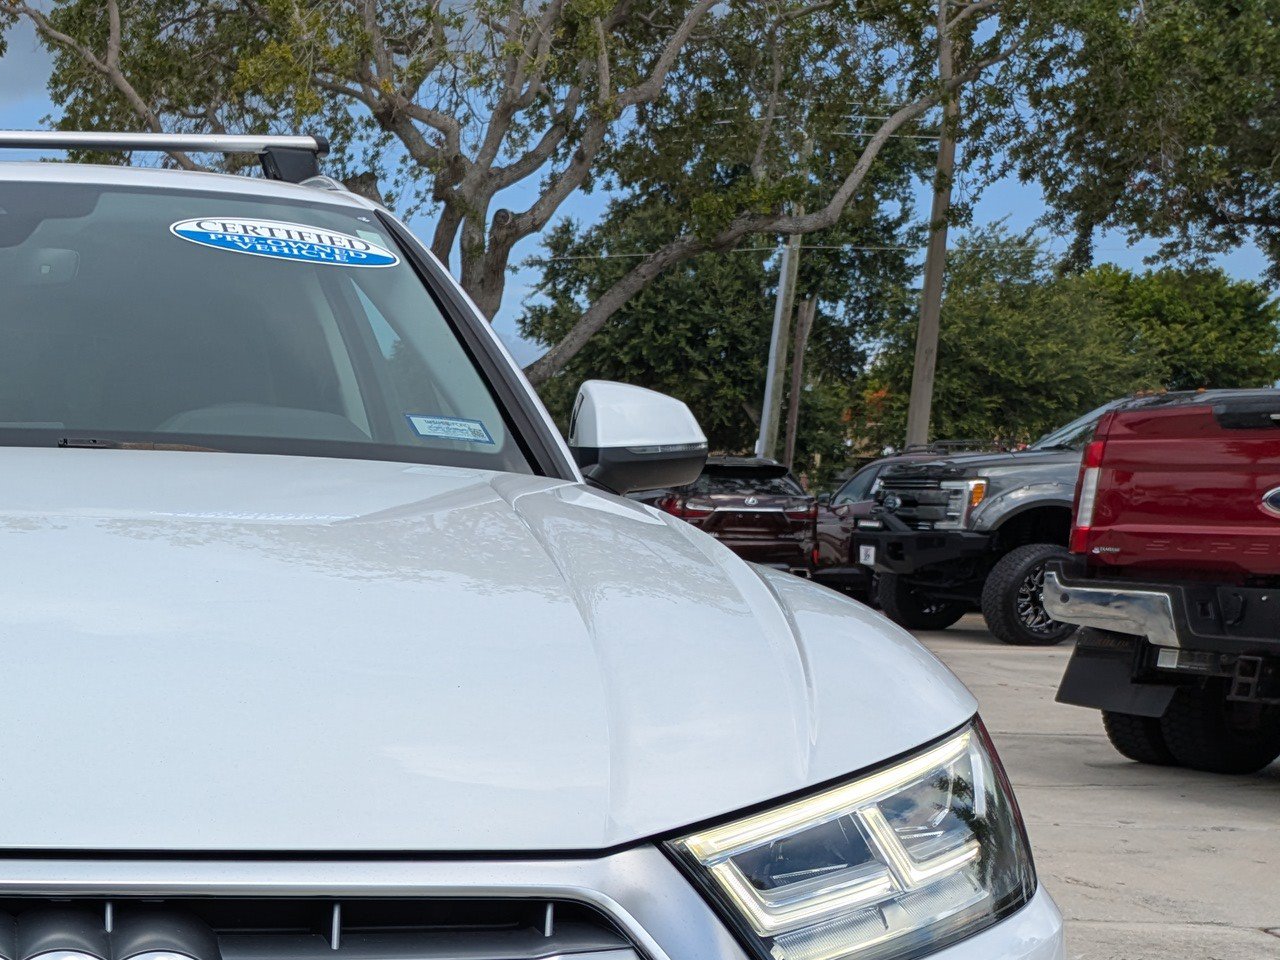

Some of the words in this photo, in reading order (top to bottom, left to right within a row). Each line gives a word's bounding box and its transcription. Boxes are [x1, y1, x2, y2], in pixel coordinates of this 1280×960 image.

[195, 221, 371, 251] CERTIFIED
[208, 233, 368, 259] PRE-OWNED
[236, 242, 349, 263] VEHICLE
[1145, 540, 1280, 556] SUPE
